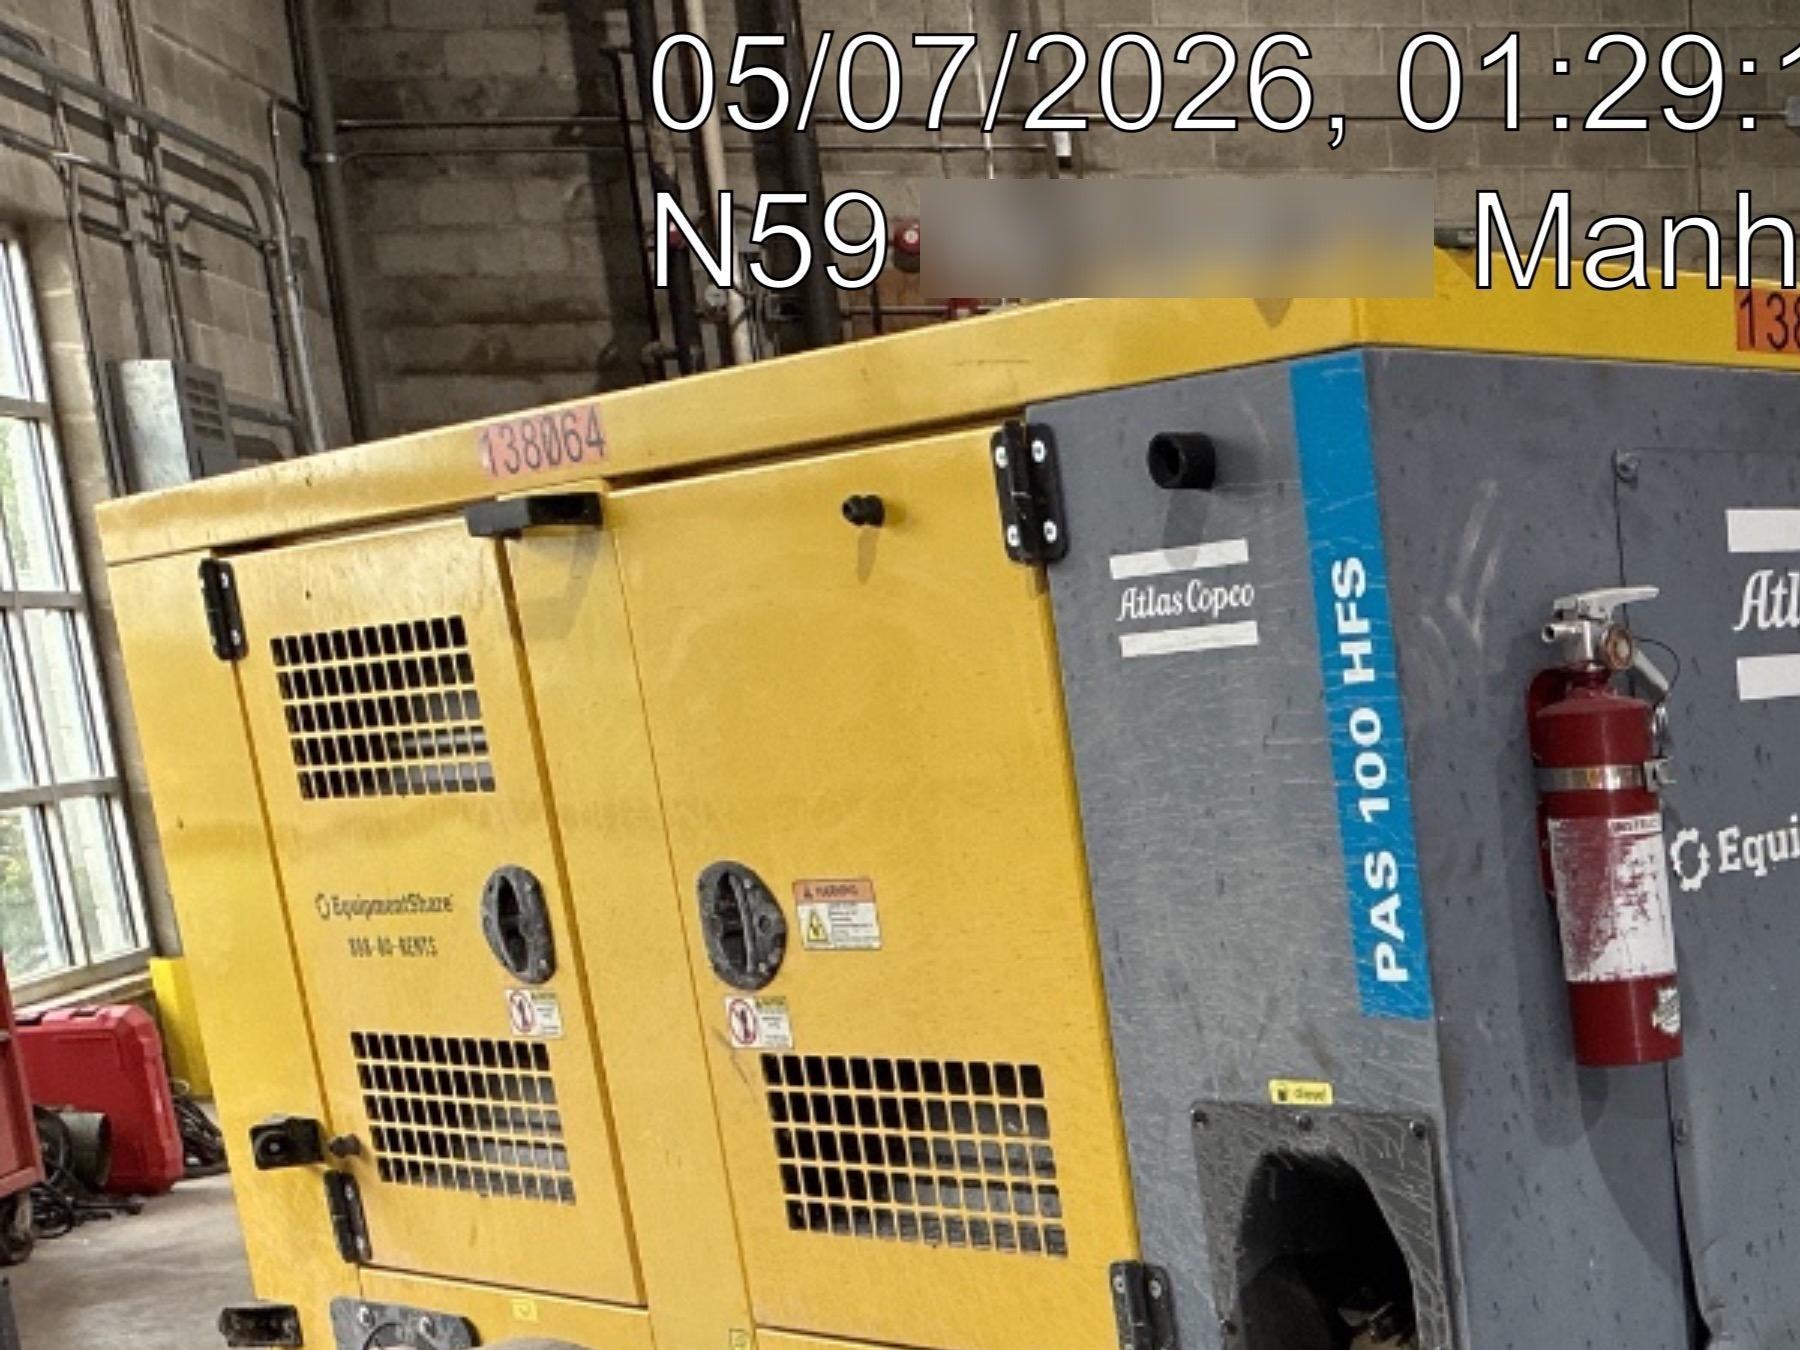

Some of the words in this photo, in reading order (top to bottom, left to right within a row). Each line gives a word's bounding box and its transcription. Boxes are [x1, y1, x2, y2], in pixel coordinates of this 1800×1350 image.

[480, 402, 605, 477] 138064
[1116, 581, 1184, 622] Atlas
[1186, 578, 1256, 618] Copco
[1332, 556, 1377, 685] HFS
[1348, 706, 1390, 824] 100
[332, 892, 454, 921] EquipmentShare
[1363, 850, 1410, 984] PAS
